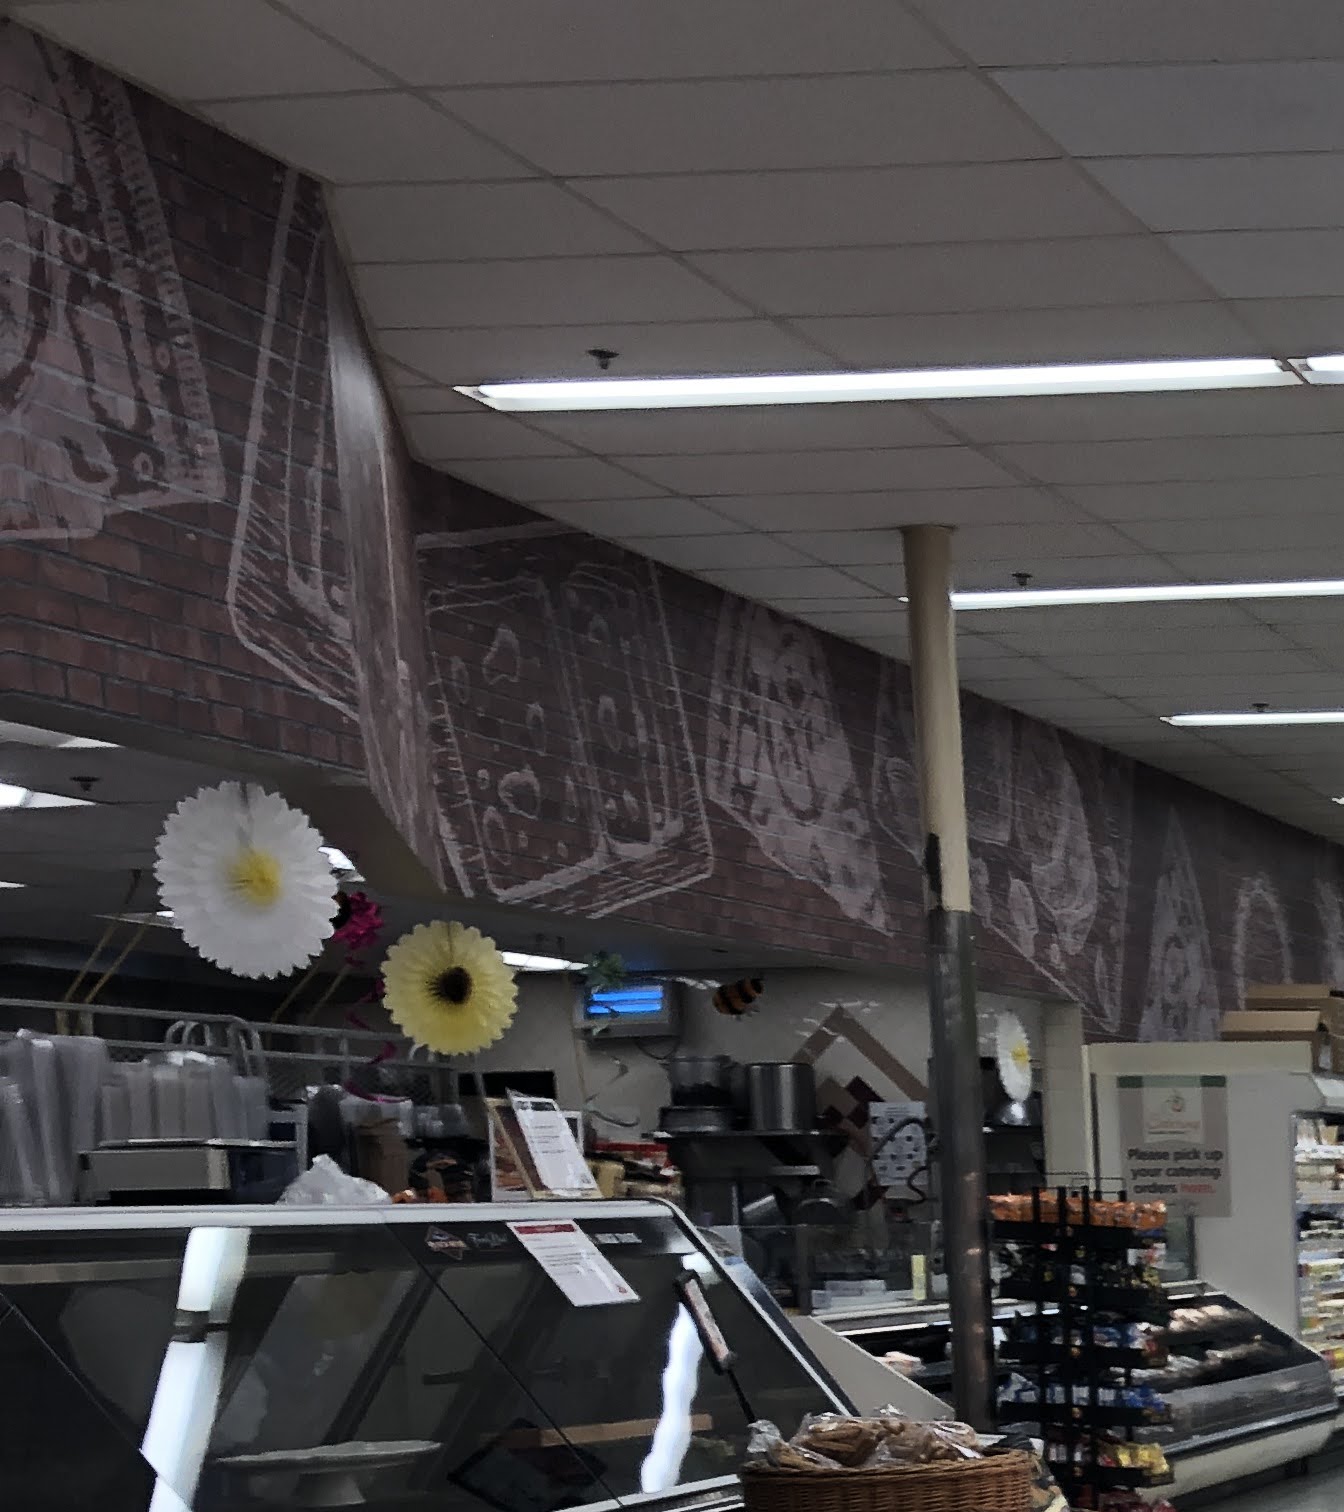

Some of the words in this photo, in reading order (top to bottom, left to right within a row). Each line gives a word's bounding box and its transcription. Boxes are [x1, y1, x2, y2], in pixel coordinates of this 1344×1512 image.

[1127, 1148, 1169, 1160] Please
[1173, 1148, 1200, 1162] pick
[1204, 1150, 1223, 1162] up
[1130, 1168, 1163, 1181] your
[1133, 1182, 1178, 1194] orders
